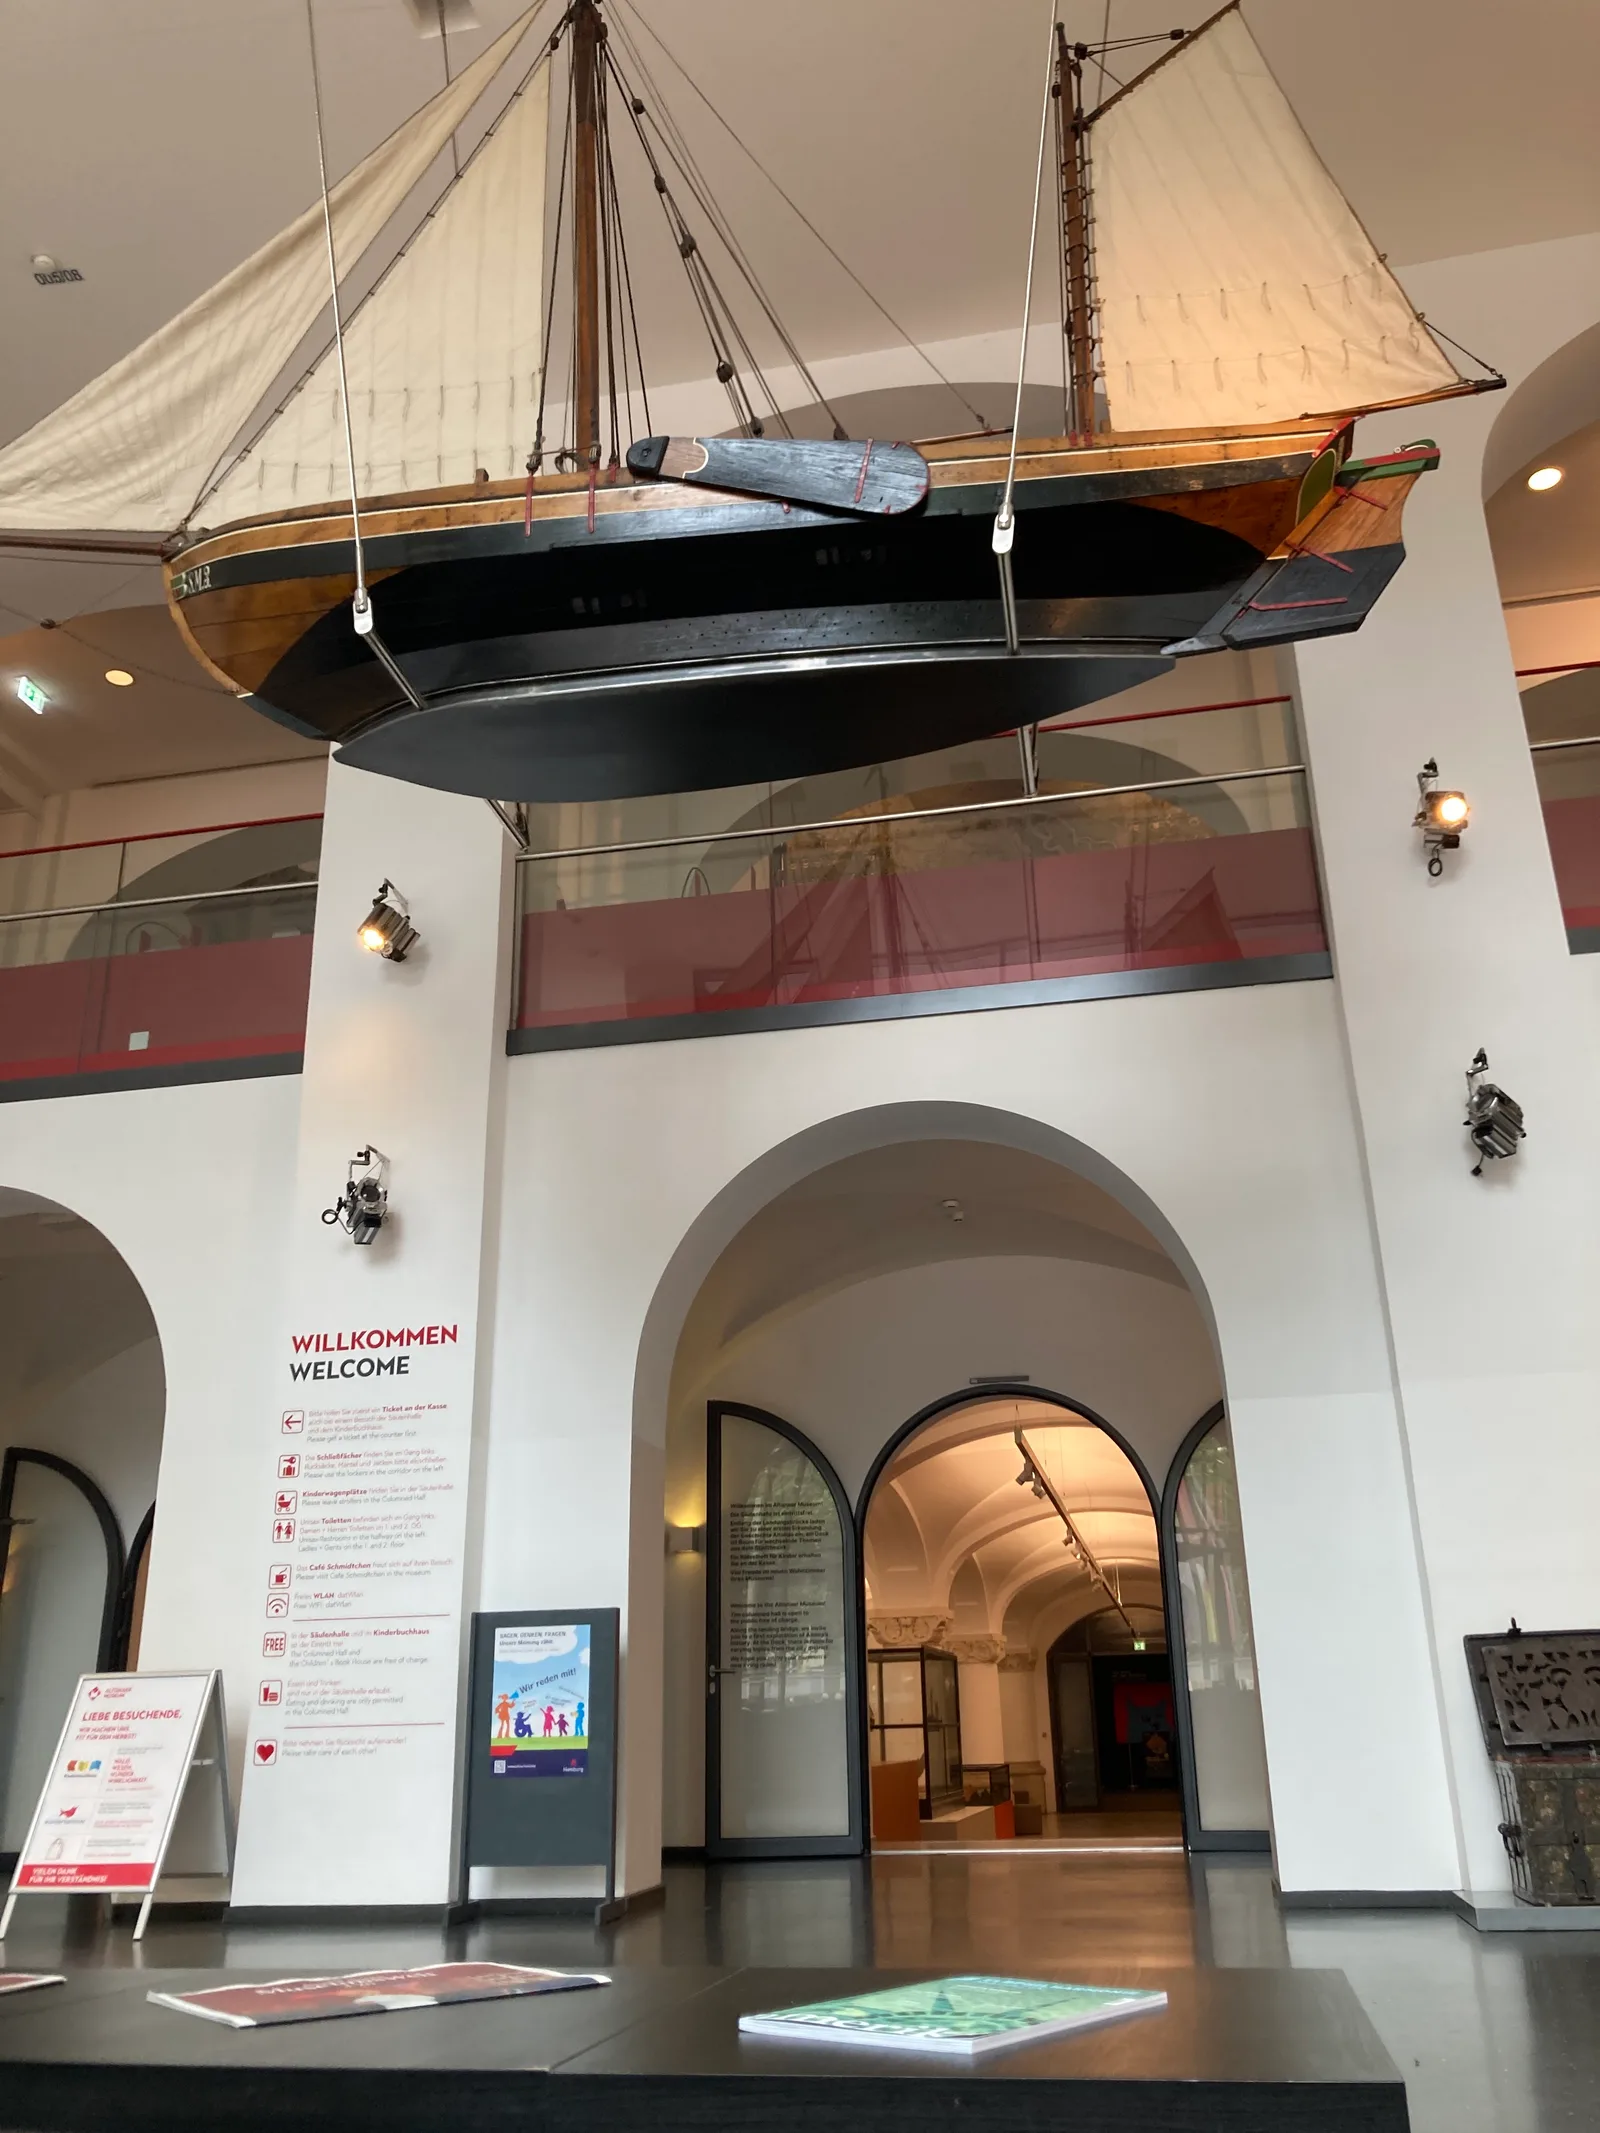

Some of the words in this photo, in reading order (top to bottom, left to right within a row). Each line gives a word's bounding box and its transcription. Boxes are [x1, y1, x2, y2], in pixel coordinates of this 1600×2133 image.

[292, 1324, 458, 1354] WILLKOMMEN
[289, 1355, 410, 1382] WELCOME
[414, 1403, 426, 1411] der
[317, 1451, 362, 1460] Schließfächer
[302, 1488, 368, 1498] Kinderwagenplätze
[321, 1516, 352, 1525] Toiletten
[309, 1563, 326, 1571] Café
[326, 1561, 371, 1570] Schmidtchen
[310, 1629, 350, 1638] Säulenhalle
[373, 1627, 430, 1636] Kinderbuchhaus
[264, 1637, 285, 1652] FREE
[518, 1683, 535, 1694] Wir
[535, 1673, 560, 1688] reden
[560, 1667, 577, 1679] mit!
[82, 1711, 111, 1722] LIEBE
[112, 1709, 182, 1721] BESUCHENDE,
